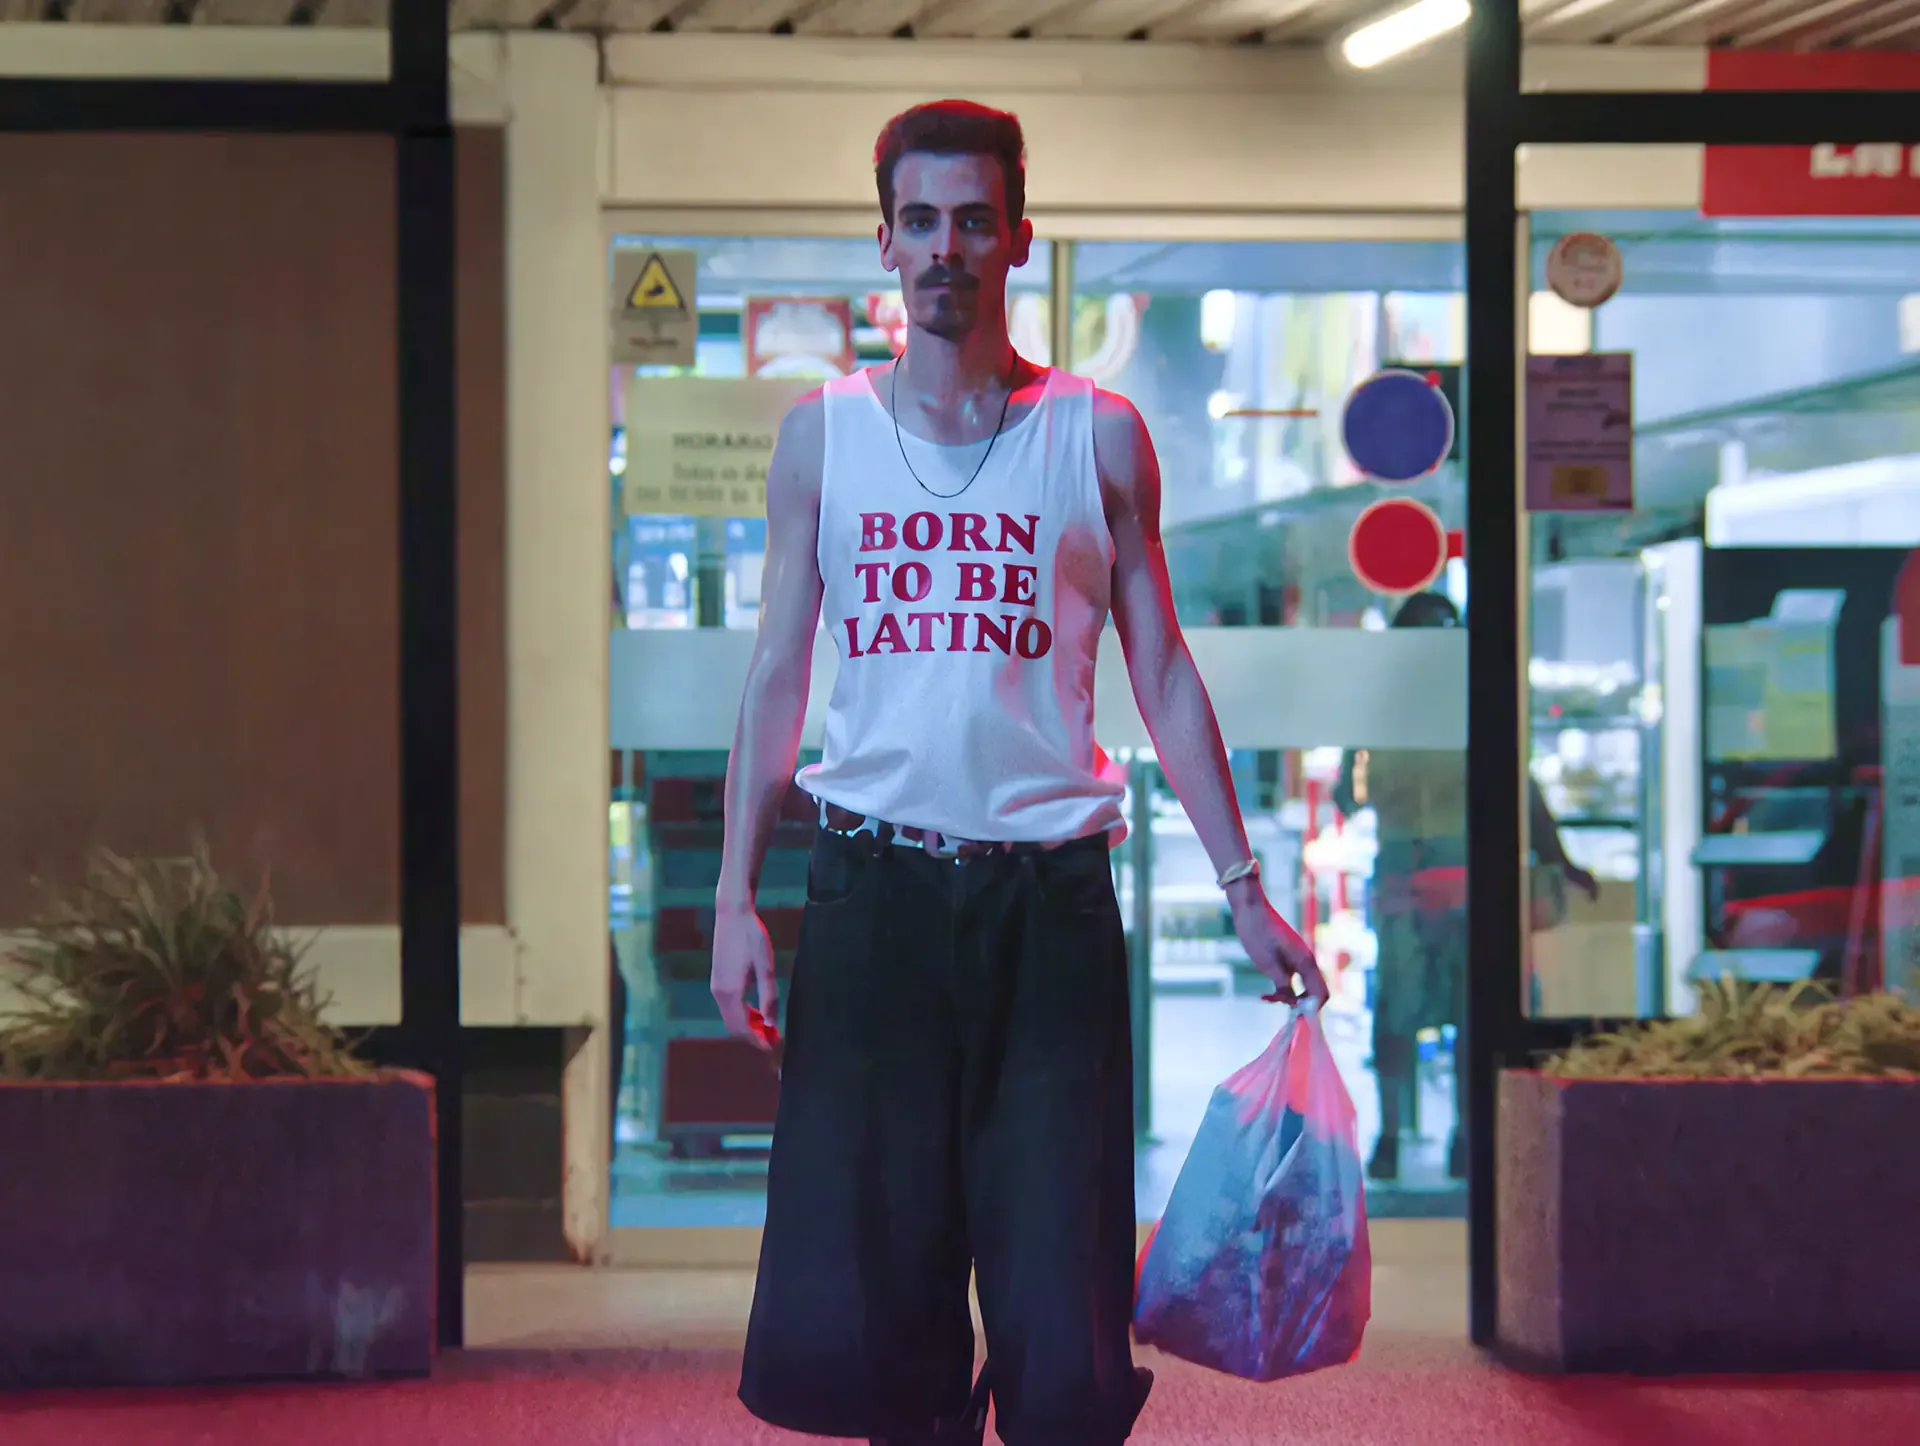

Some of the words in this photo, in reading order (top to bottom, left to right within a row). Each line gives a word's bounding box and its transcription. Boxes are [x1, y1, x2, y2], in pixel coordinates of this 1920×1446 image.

[859, 511, 1040, 555] BORN
[854, 561, 932, 603] TO
[955, 562, 1038, 607] BE
[843, 612, 1053, 660] LATINO
